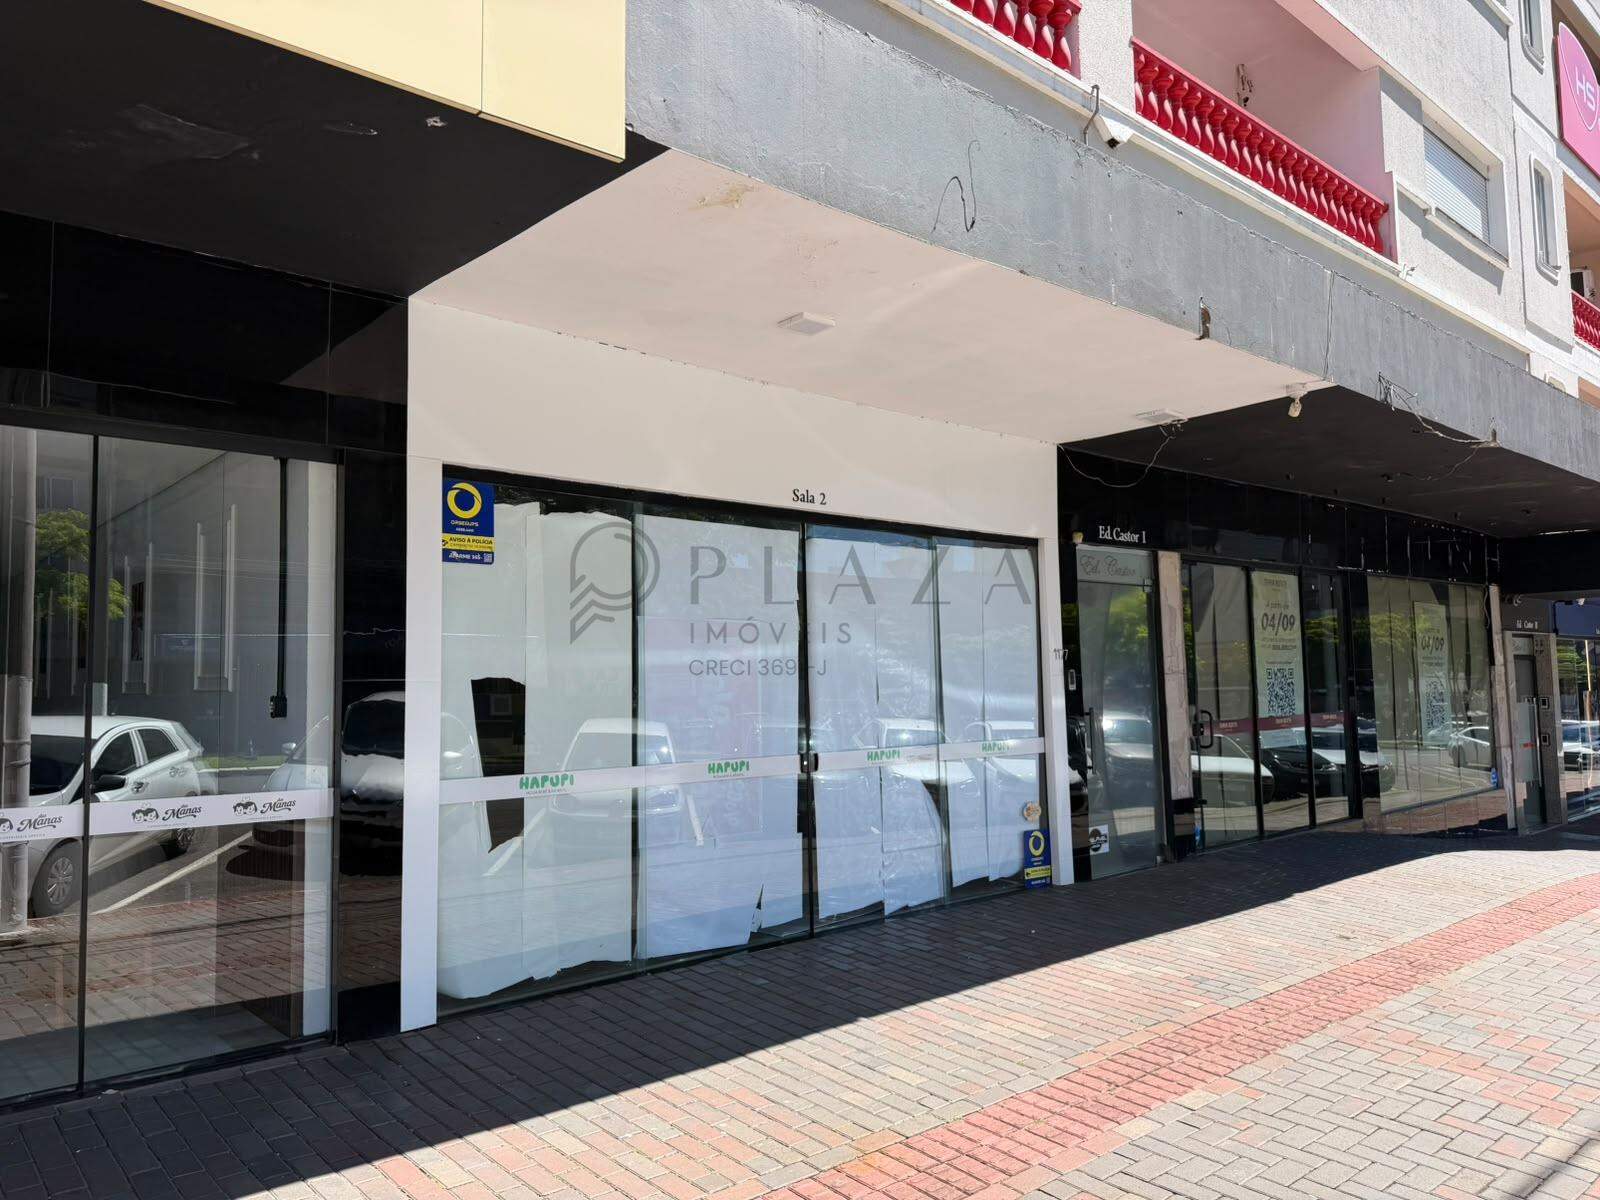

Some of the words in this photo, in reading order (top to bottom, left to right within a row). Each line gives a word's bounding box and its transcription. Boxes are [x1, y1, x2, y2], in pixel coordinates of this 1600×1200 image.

[792, 488, 815, 504] Sala
[819, 492, 827, 505] 2
[1098, 525, 1112, 539] Ed.
[1113, 527, 1140, 543] Castor
[1261, 611, 1296, 636] 04/09
[866, 750, 900, 762] HAPUPI
[708, 760, 750, 774] HAPUPI
[519, 773, 575, 790] HAPUPI
[162, 806, 202, 821] Manas
[260, 799, 296, 814] Manas
[17, 815, 63, 832] Manas
